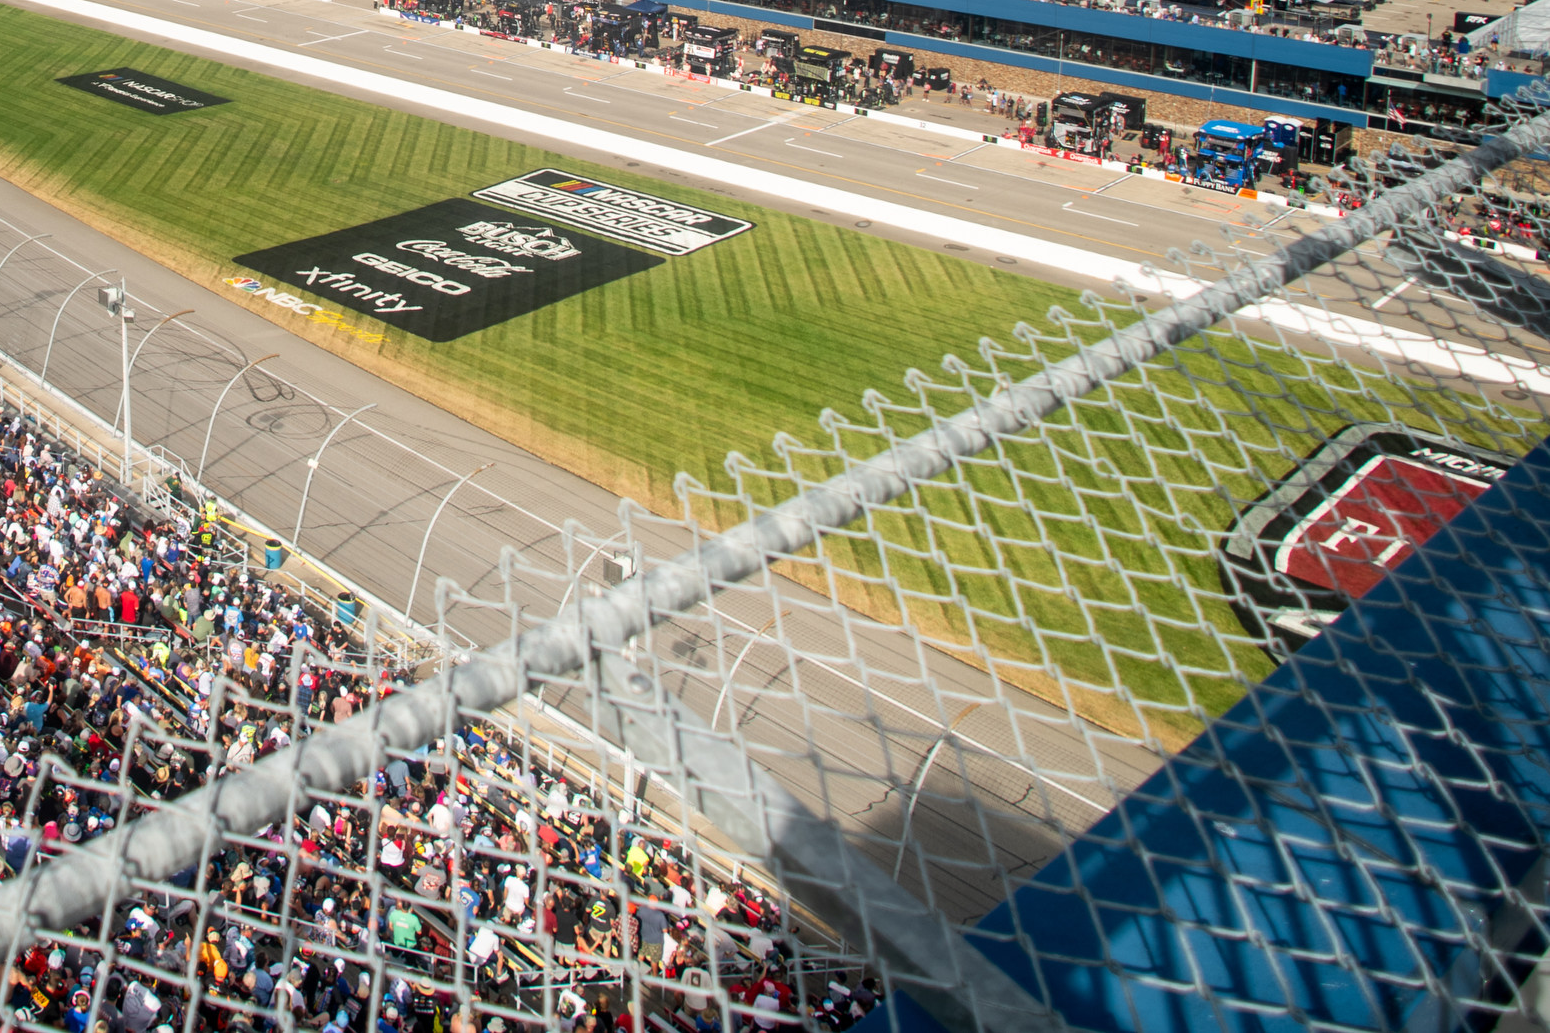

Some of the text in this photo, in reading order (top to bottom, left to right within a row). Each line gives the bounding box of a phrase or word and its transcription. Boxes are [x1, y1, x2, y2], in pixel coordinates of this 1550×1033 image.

[518, 190, 675, 238] CUP SERIES
[588, 188, 713, 225] NASCAR
[455, 221, 582, 260] BUSCH
[463, 233, 533, 257] LIGHT
[352, 252, 471, 296] GEICO
[255, 287, 323, 315] NBC
